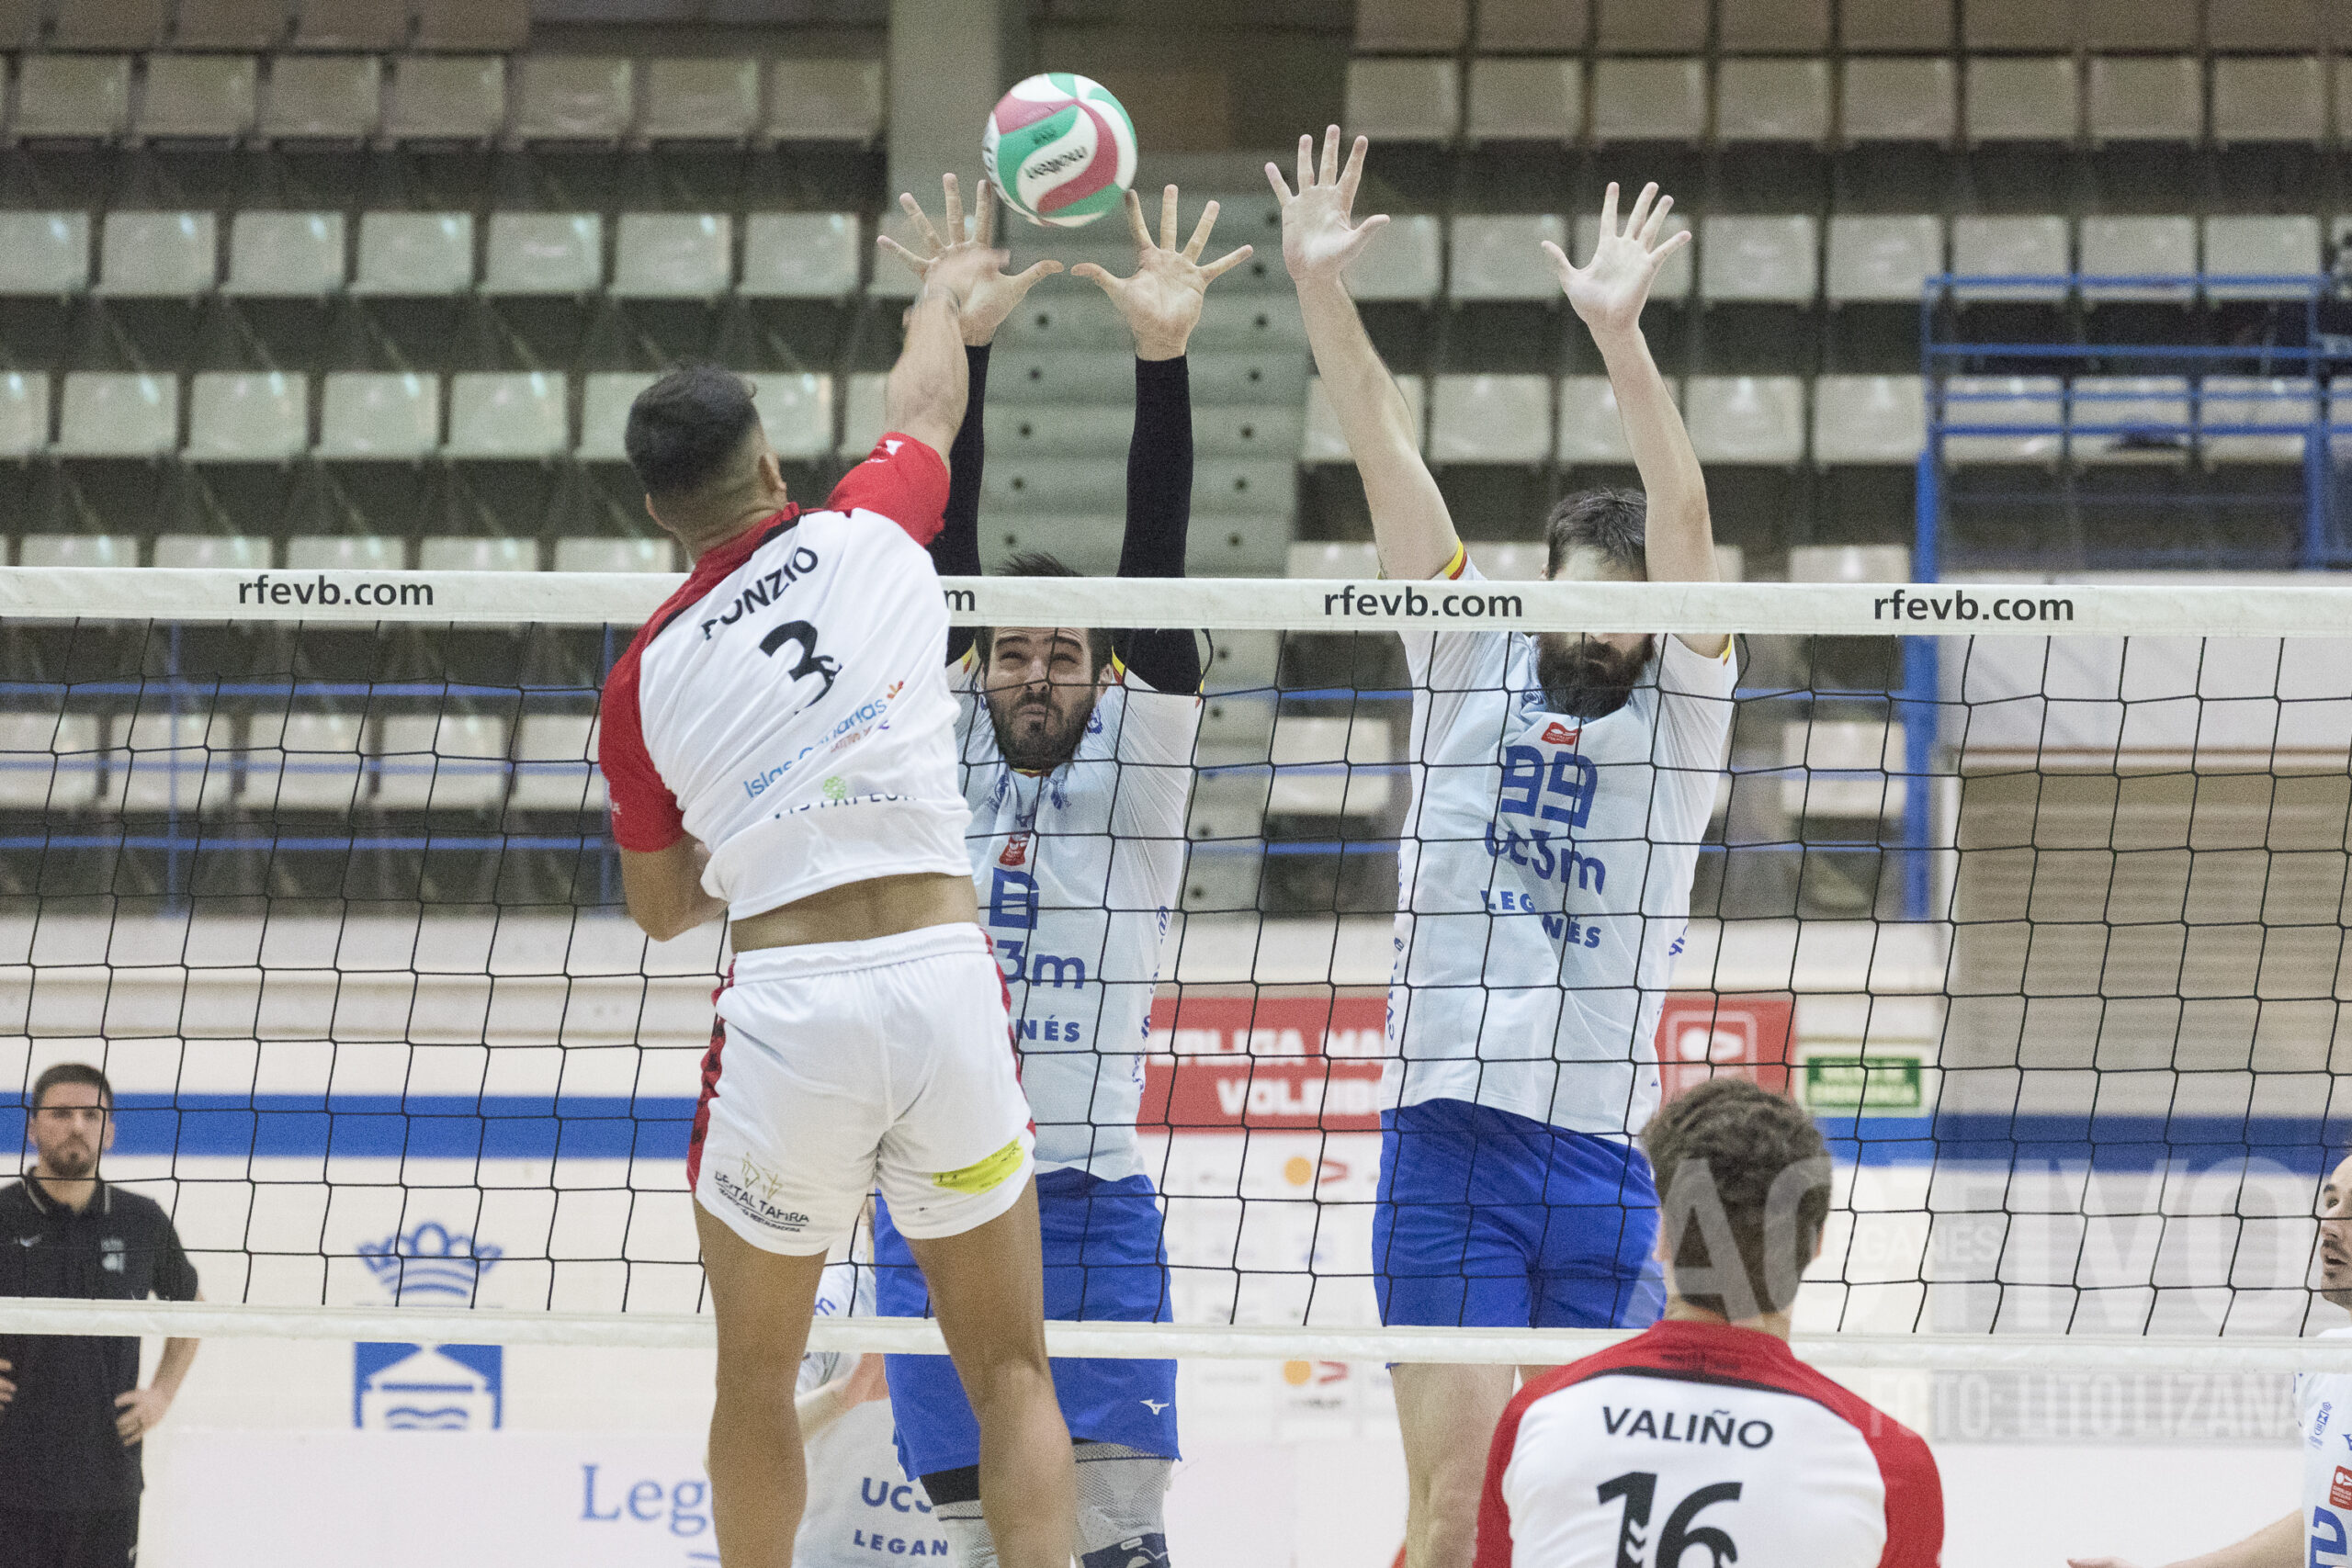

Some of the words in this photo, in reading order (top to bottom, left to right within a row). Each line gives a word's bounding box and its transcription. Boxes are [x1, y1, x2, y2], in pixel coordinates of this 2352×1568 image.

[239, 574, 434, 606] rfevb.com
[1325, 585, 1522, 617] rfevb.com
[1874, 589, 2074, 621] rfevb.com
[759, 619, 838, 716] 3
[1500, 745, 1598, 829] 99
[1602, 1405, 1773, 1449] VALIÑO
[1596, 1471, 1743, 1568] 16
[854, 1529, 948, 1556] LEGAN
